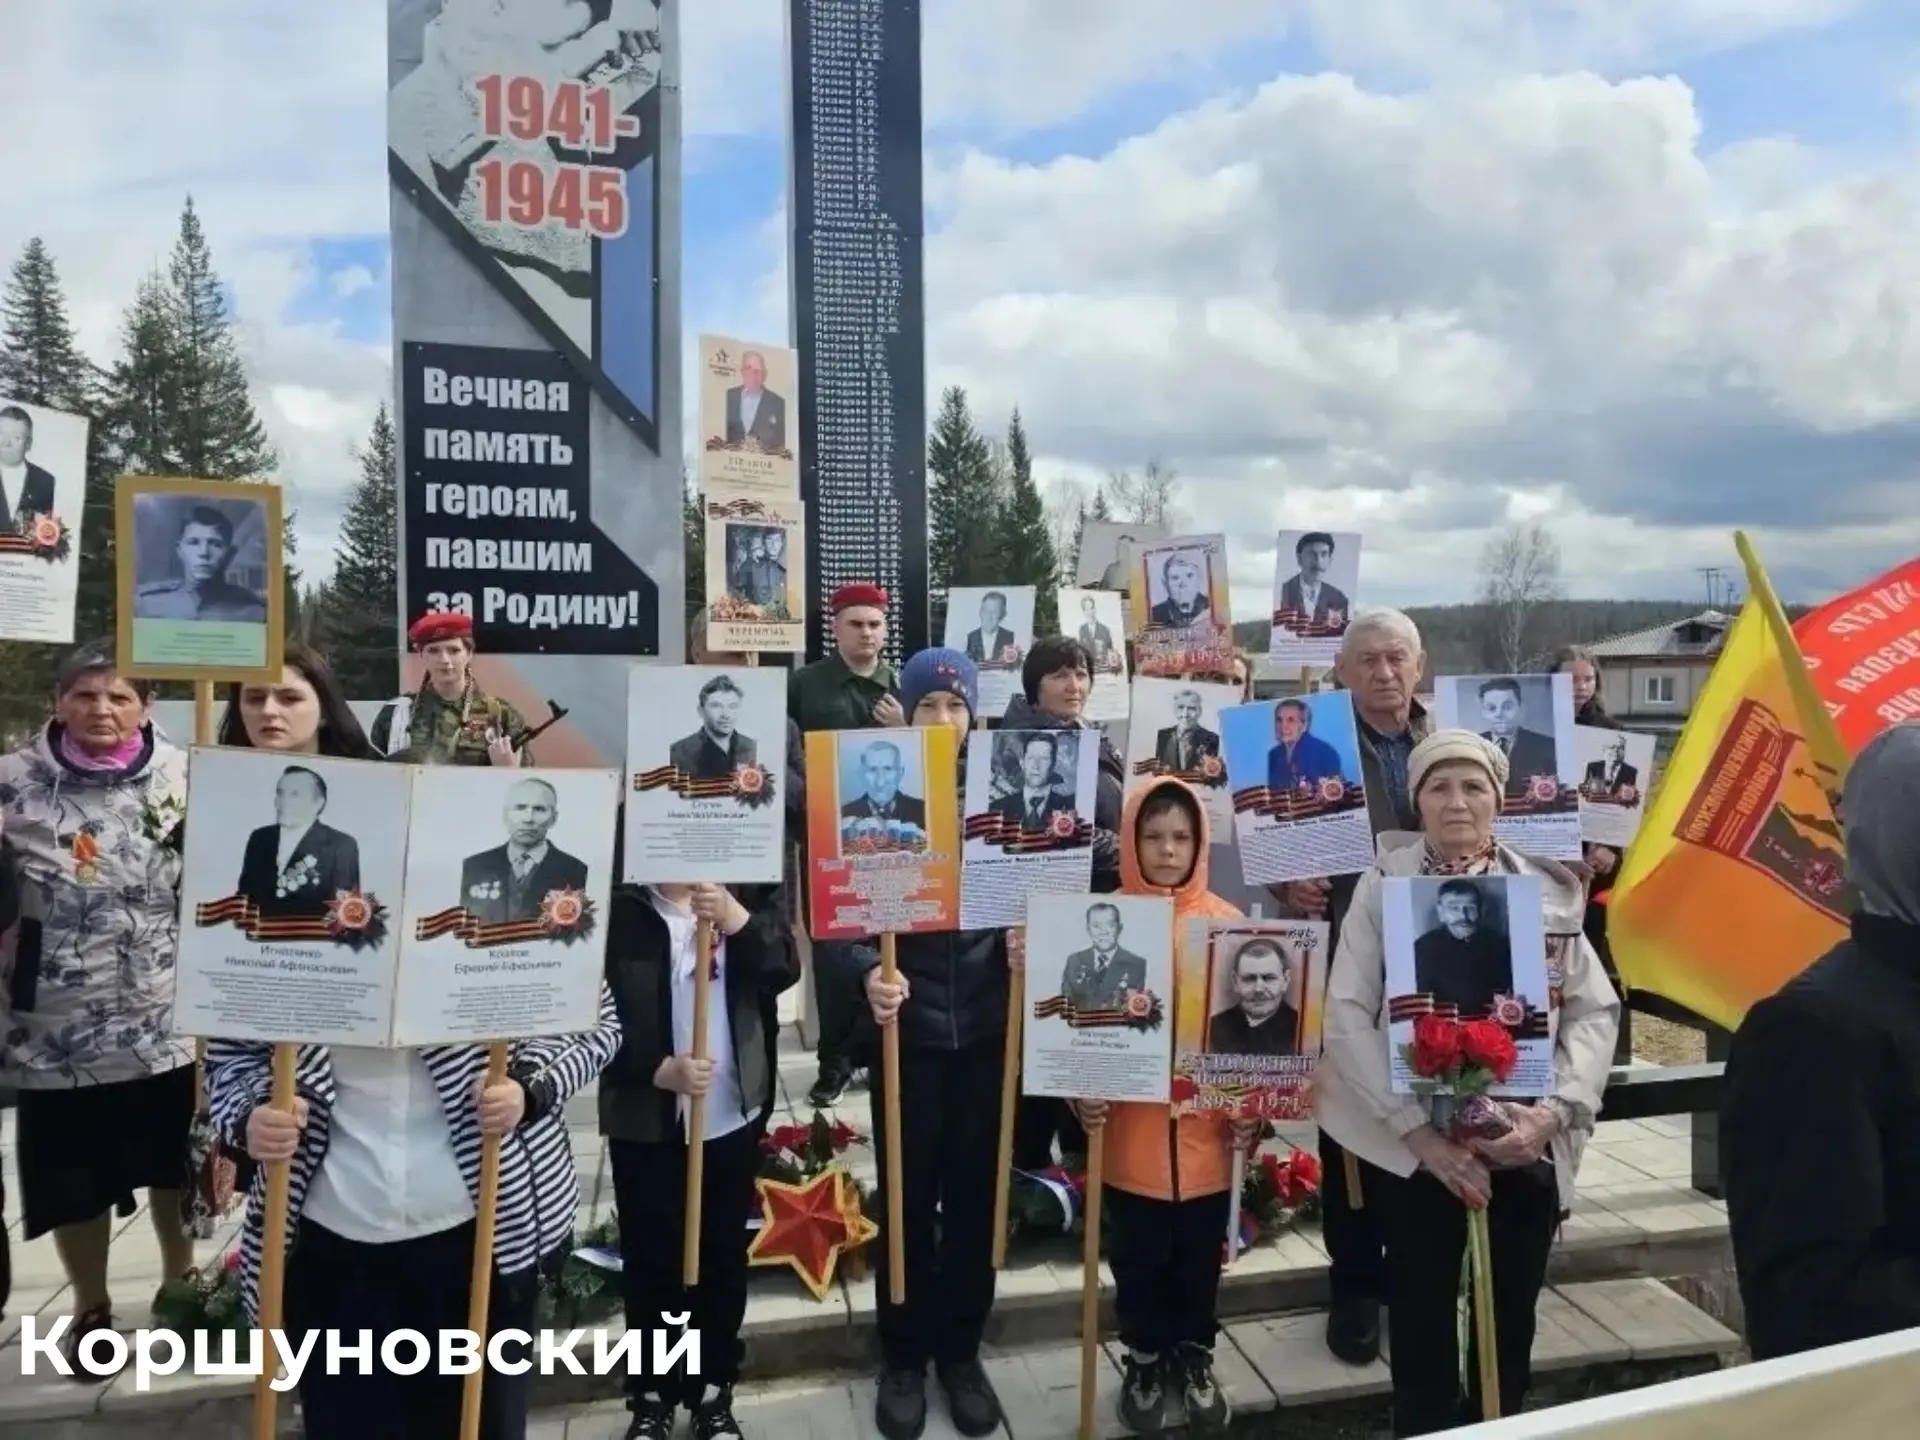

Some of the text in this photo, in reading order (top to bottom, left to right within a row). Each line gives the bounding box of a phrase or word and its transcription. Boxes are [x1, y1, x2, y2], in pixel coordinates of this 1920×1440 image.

[474, 73, 638, 150] 1941-
[474, 160, 627, 236] 1945
[424, 367, 569, 411] Вечная
[424, 428, 573, 465] память
[425, 483, 577, 523] героям,
[426, 537, 592, 572] павшим
[483, 587, 639, 629] Родину!
